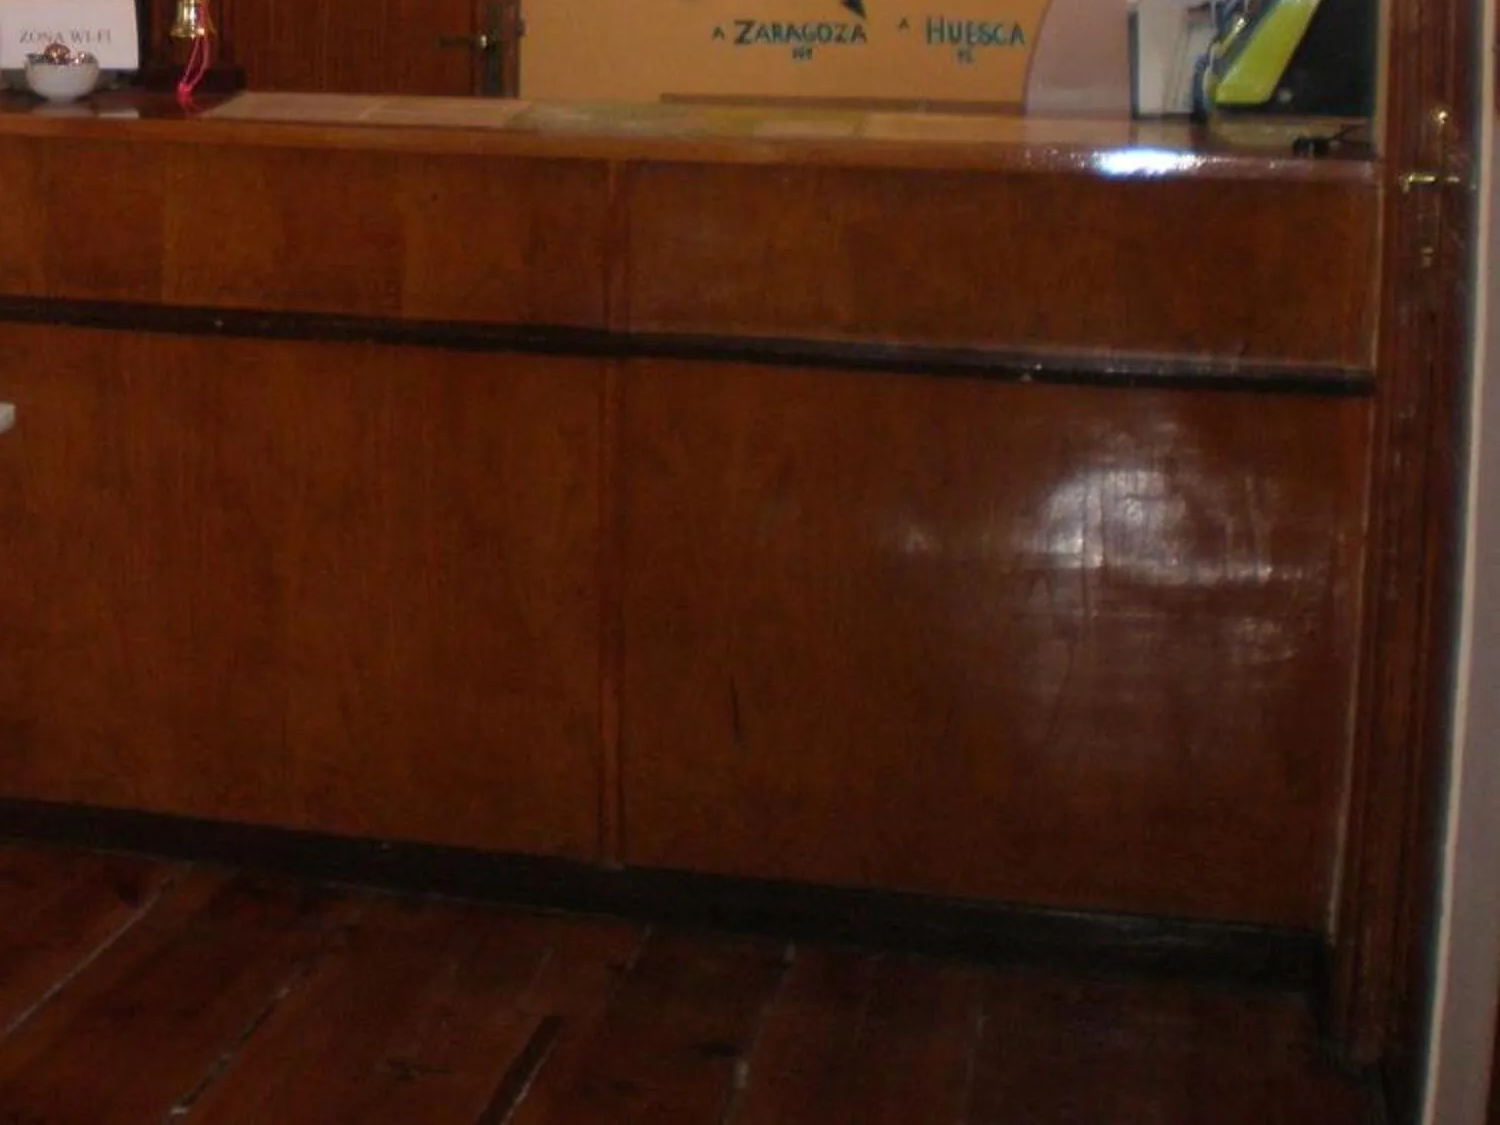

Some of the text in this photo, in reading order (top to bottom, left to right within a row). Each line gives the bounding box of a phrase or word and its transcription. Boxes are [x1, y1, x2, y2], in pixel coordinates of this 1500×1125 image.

[19, 28, 66, 44] ZONA
[733, 20, 869, 46] ZARAGOZA
[925, 16, 1026, 47] HUESCA
